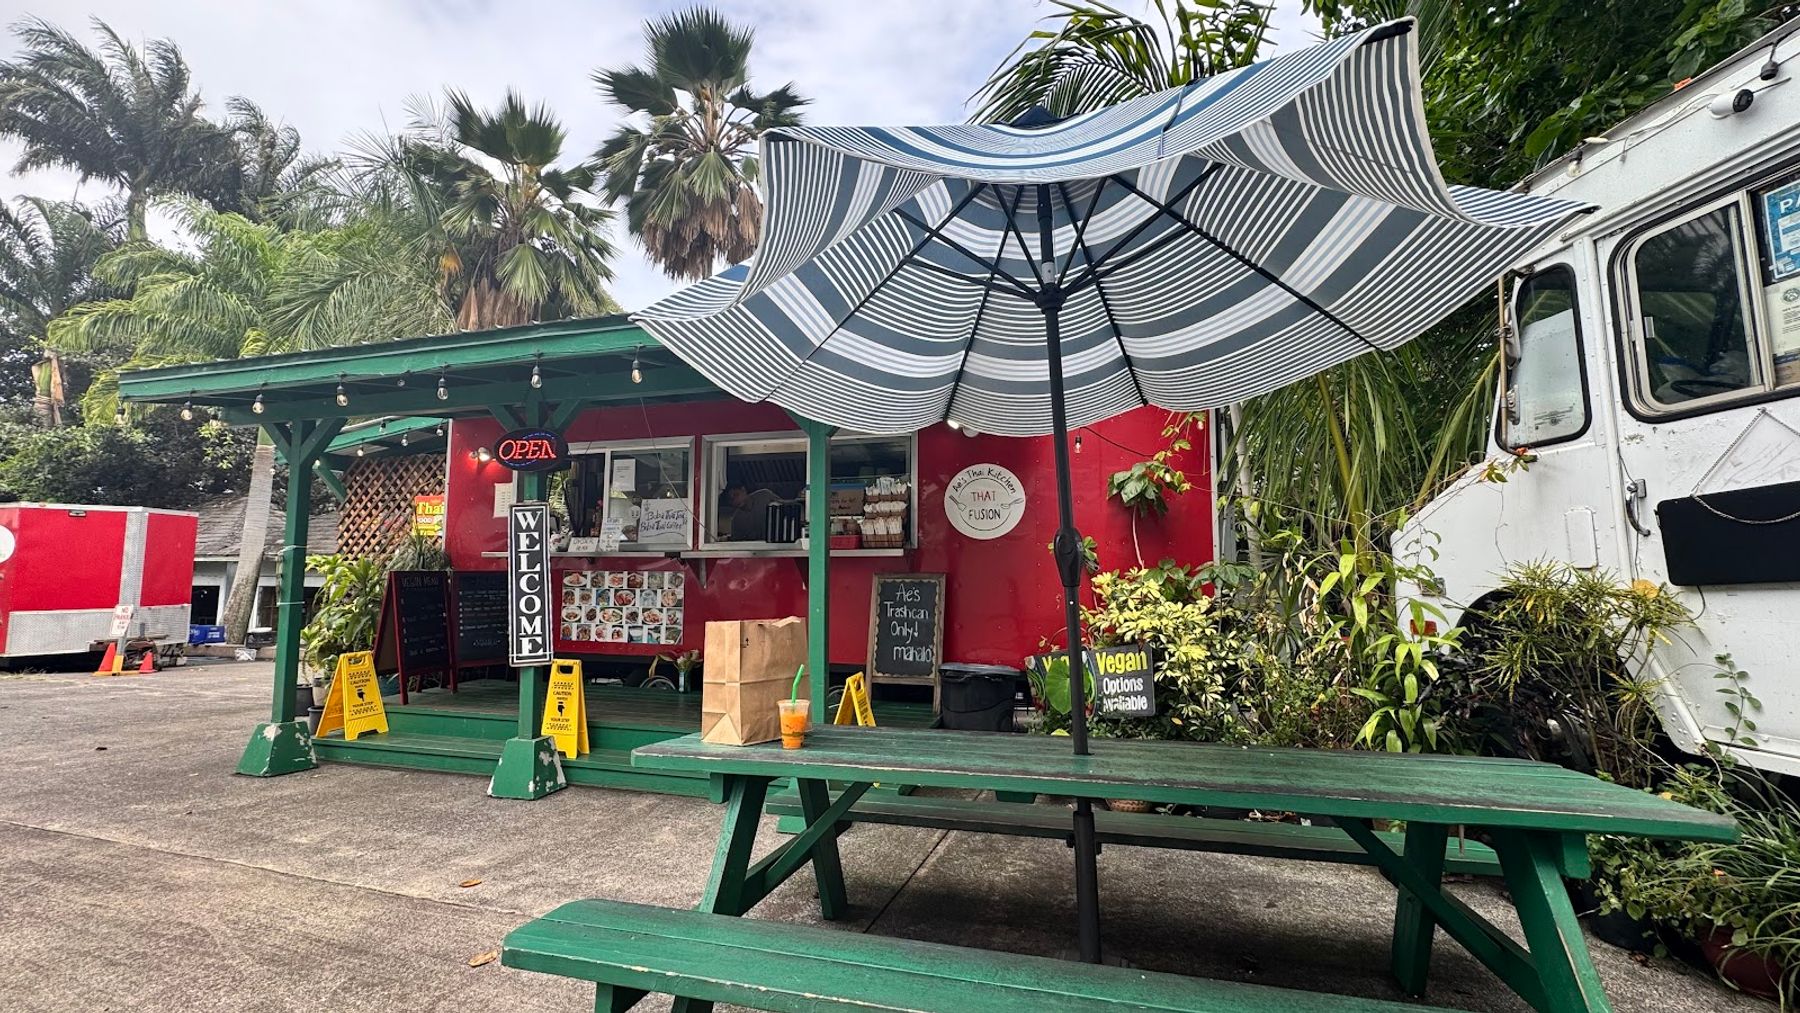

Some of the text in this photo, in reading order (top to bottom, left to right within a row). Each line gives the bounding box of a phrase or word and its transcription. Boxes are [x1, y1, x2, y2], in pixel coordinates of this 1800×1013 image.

[499, 439, 557, 460] OPEN
[952, 467, 1017, 494] Ae's Thai Kitchen
[416, 501, 445, 515] Thai
[968, 508, 1001, 520] FUSION
[515, 511, 544, 657] WELCOME
[896, 583, 921, 602] Ae's
[883, 601, 929, 619] Trashcan
[890, 620, 919, 644] Only!
[1095, 650, 1148, 675] Vegan
[1103, 677, 1144, 696] Options
